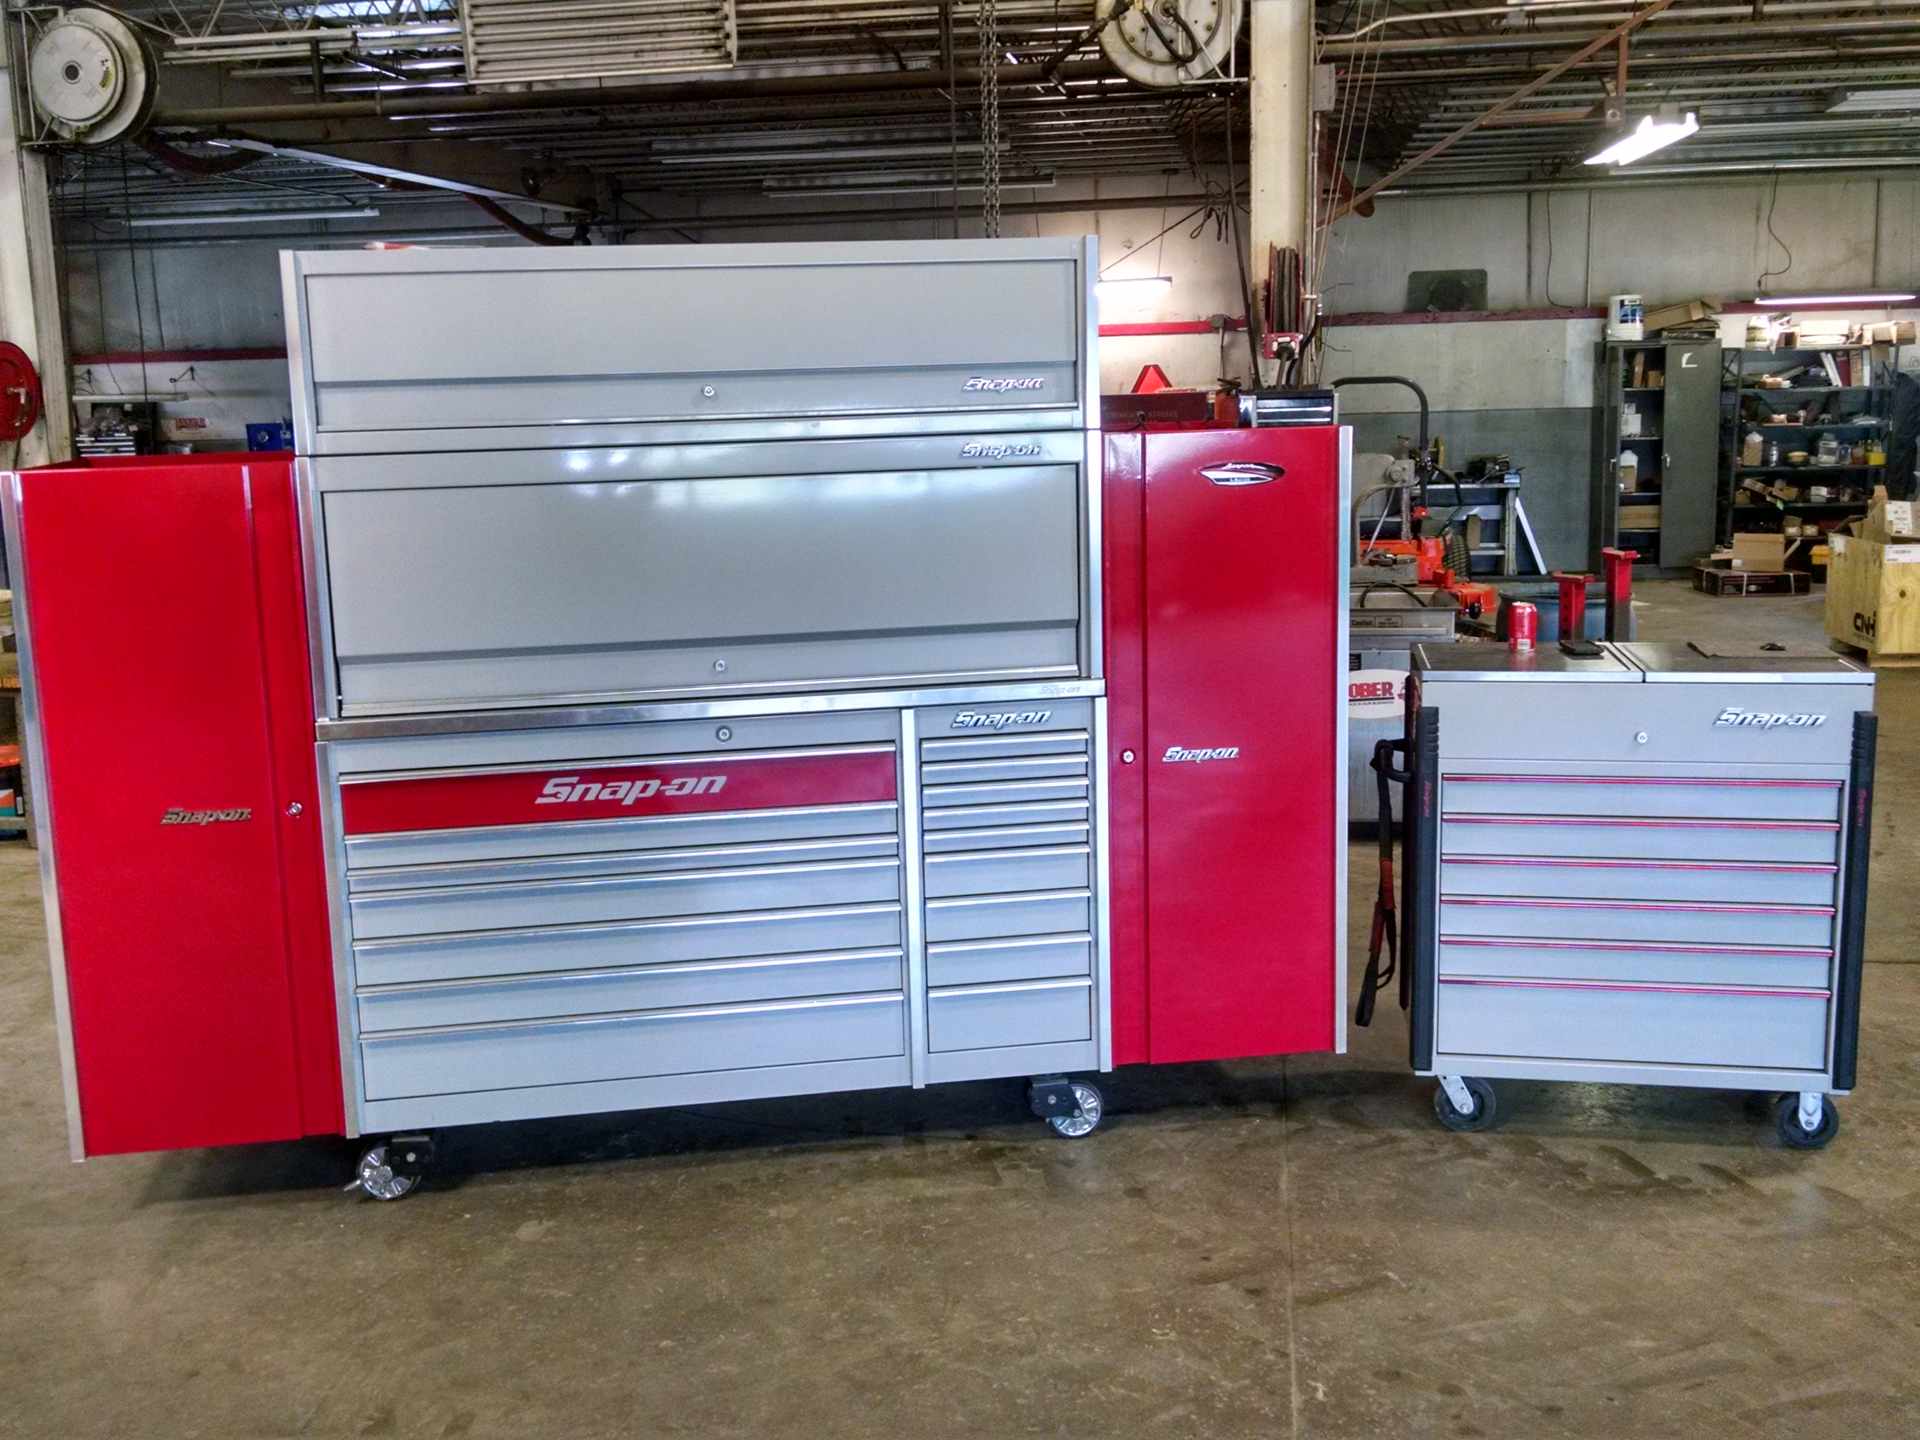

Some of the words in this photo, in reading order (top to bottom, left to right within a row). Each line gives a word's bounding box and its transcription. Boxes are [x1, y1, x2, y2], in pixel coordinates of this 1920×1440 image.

[963, 377, 1044, 394] Snap-on
[1106, 410, 1138, 420] CHEMICA
[961, 443, 1041, 460] Snap-on
[1038, 685, 1081, 697] Snap-on
[951, 709, 1051, 729] Snap-on
[1712, 707, 1827, 731] Snap-on
[1162, 746, 1239, 763] Snap-on
[534, 775, 727, 806] Snap-on
[160, 808, 252, 826] Snap-on
